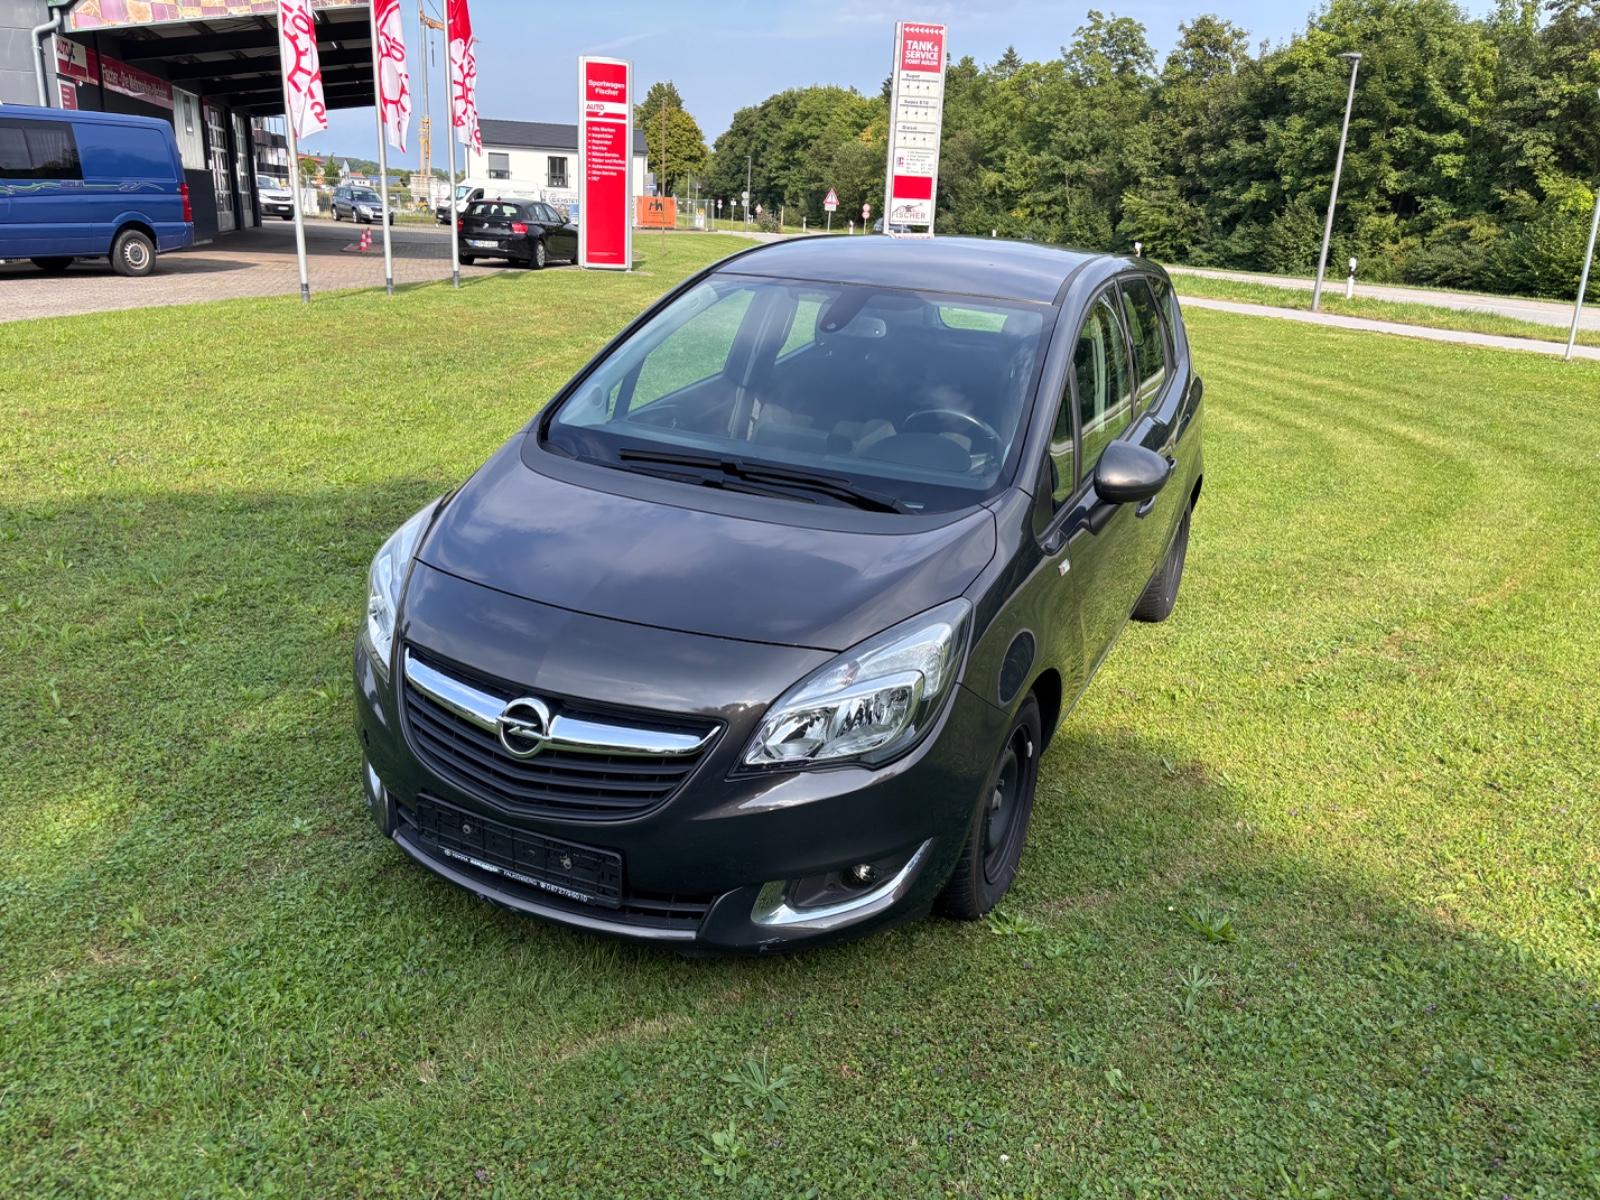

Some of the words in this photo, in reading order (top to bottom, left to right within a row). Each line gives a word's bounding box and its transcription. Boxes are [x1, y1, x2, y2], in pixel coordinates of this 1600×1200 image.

[905, 40, 934, 51] TANK
[905, 50, 939, 61] SERVICE
[588, 79, 625, 90] Sportwagen
[595, 87, 619, 96] Fischer
[586, 103, 605, 111] AUTO
[891, 211, 926, 220] FISCHER
